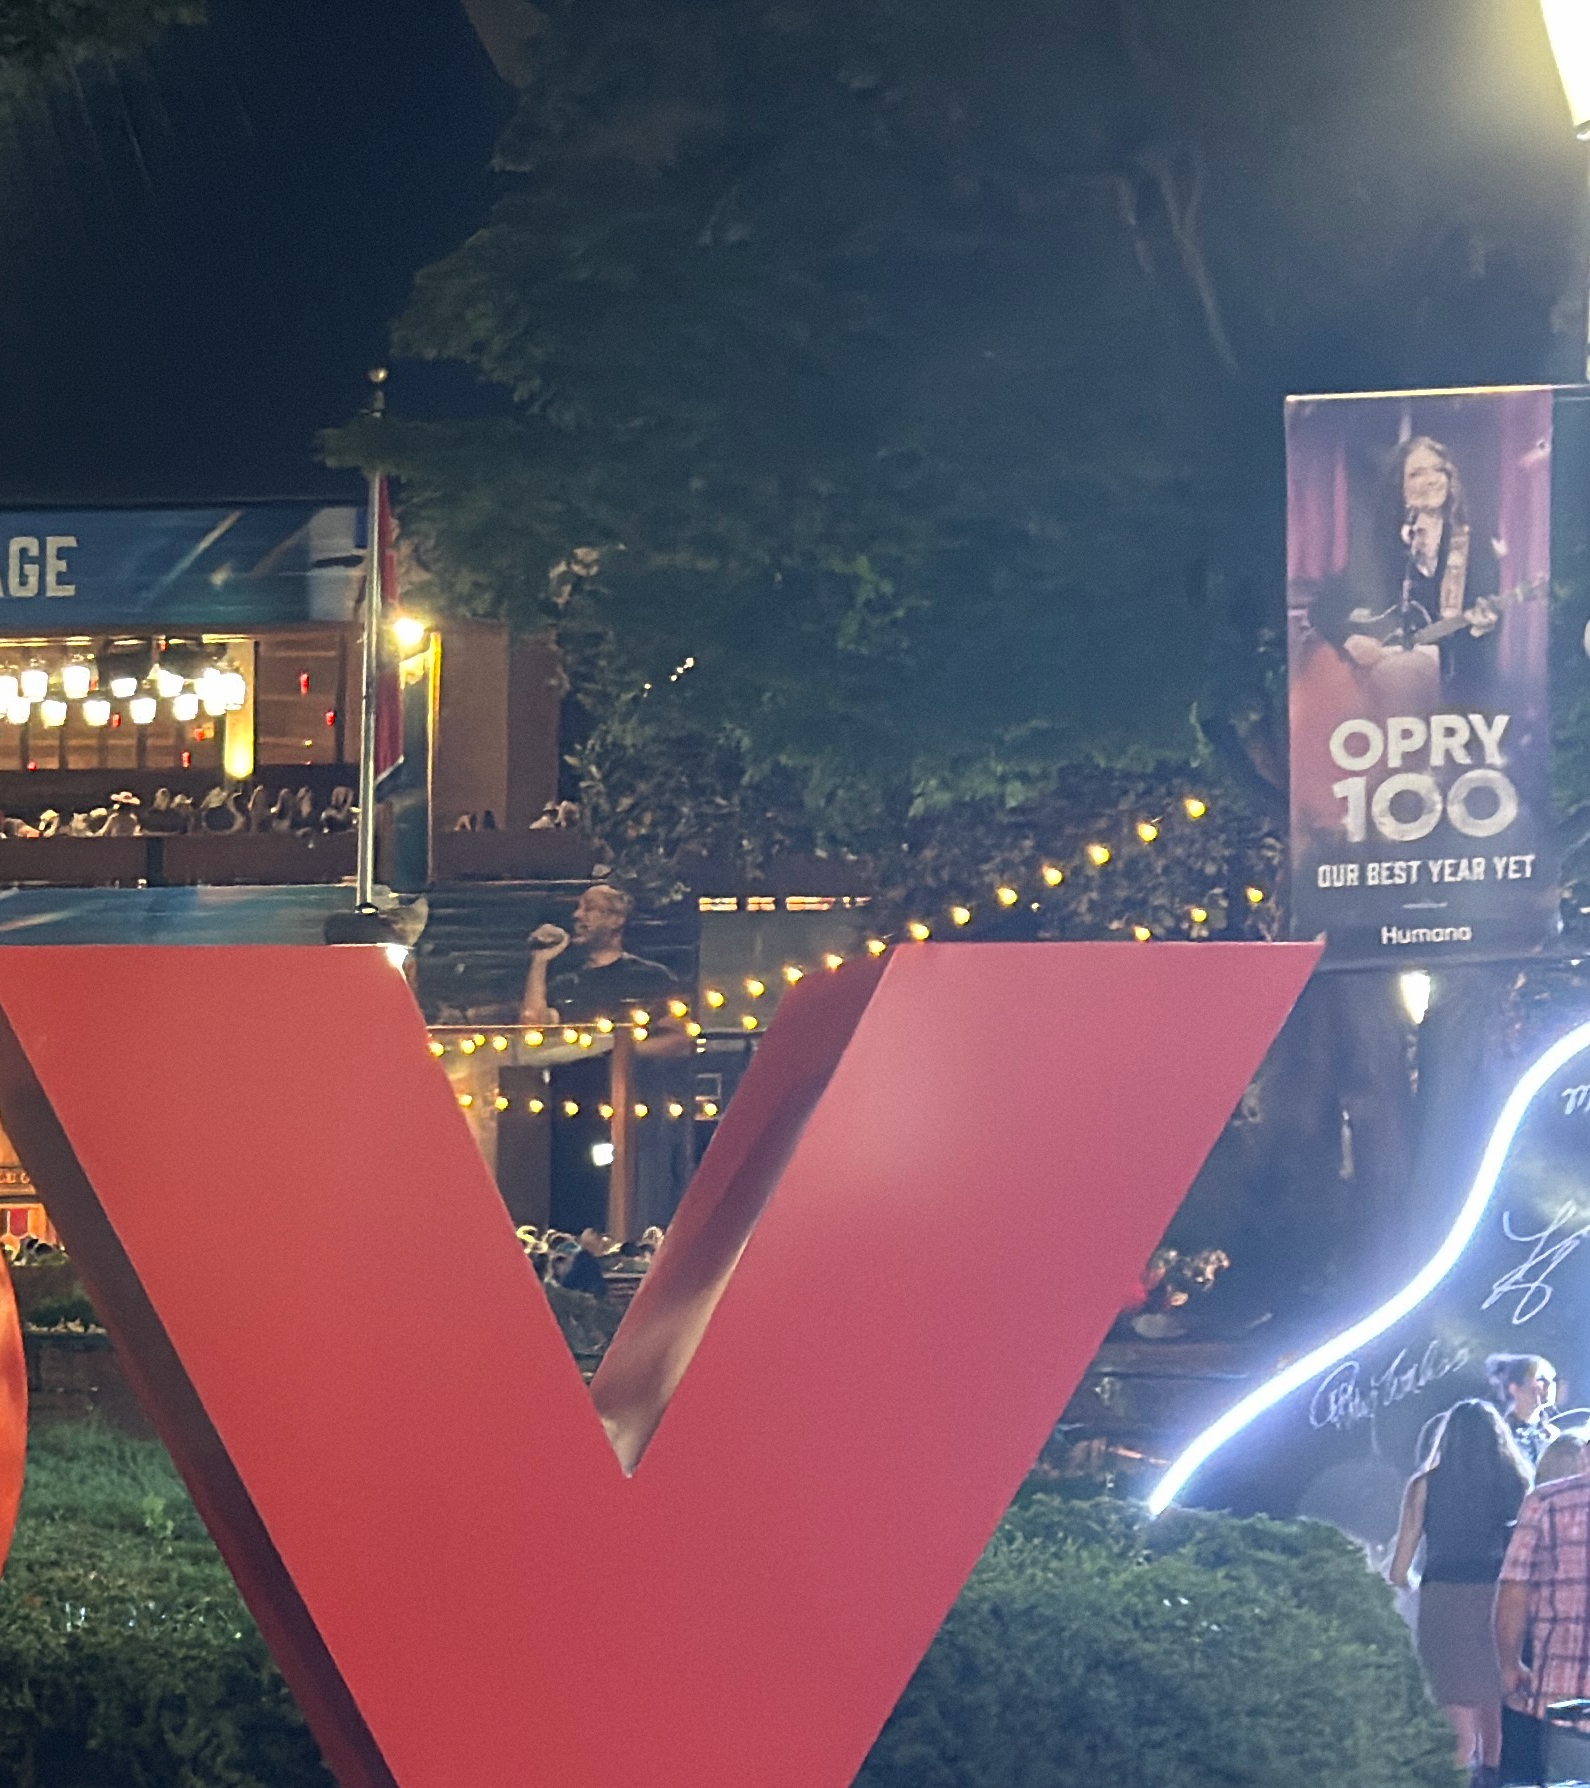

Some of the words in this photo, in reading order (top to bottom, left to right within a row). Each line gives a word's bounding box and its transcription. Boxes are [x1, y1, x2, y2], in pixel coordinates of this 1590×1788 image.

[1328, 713, 1510, 771] OPRY
[1331, 768, 1518, 843] 100
[1317, 863, 1360, 888] OUR
[1366, 860, 1422, 886] BEST
[1428, 857, 1485, 883] YEAR
[1492, 853, 1536, 880] YET
[1380, 926, 1473, 945] Humana
